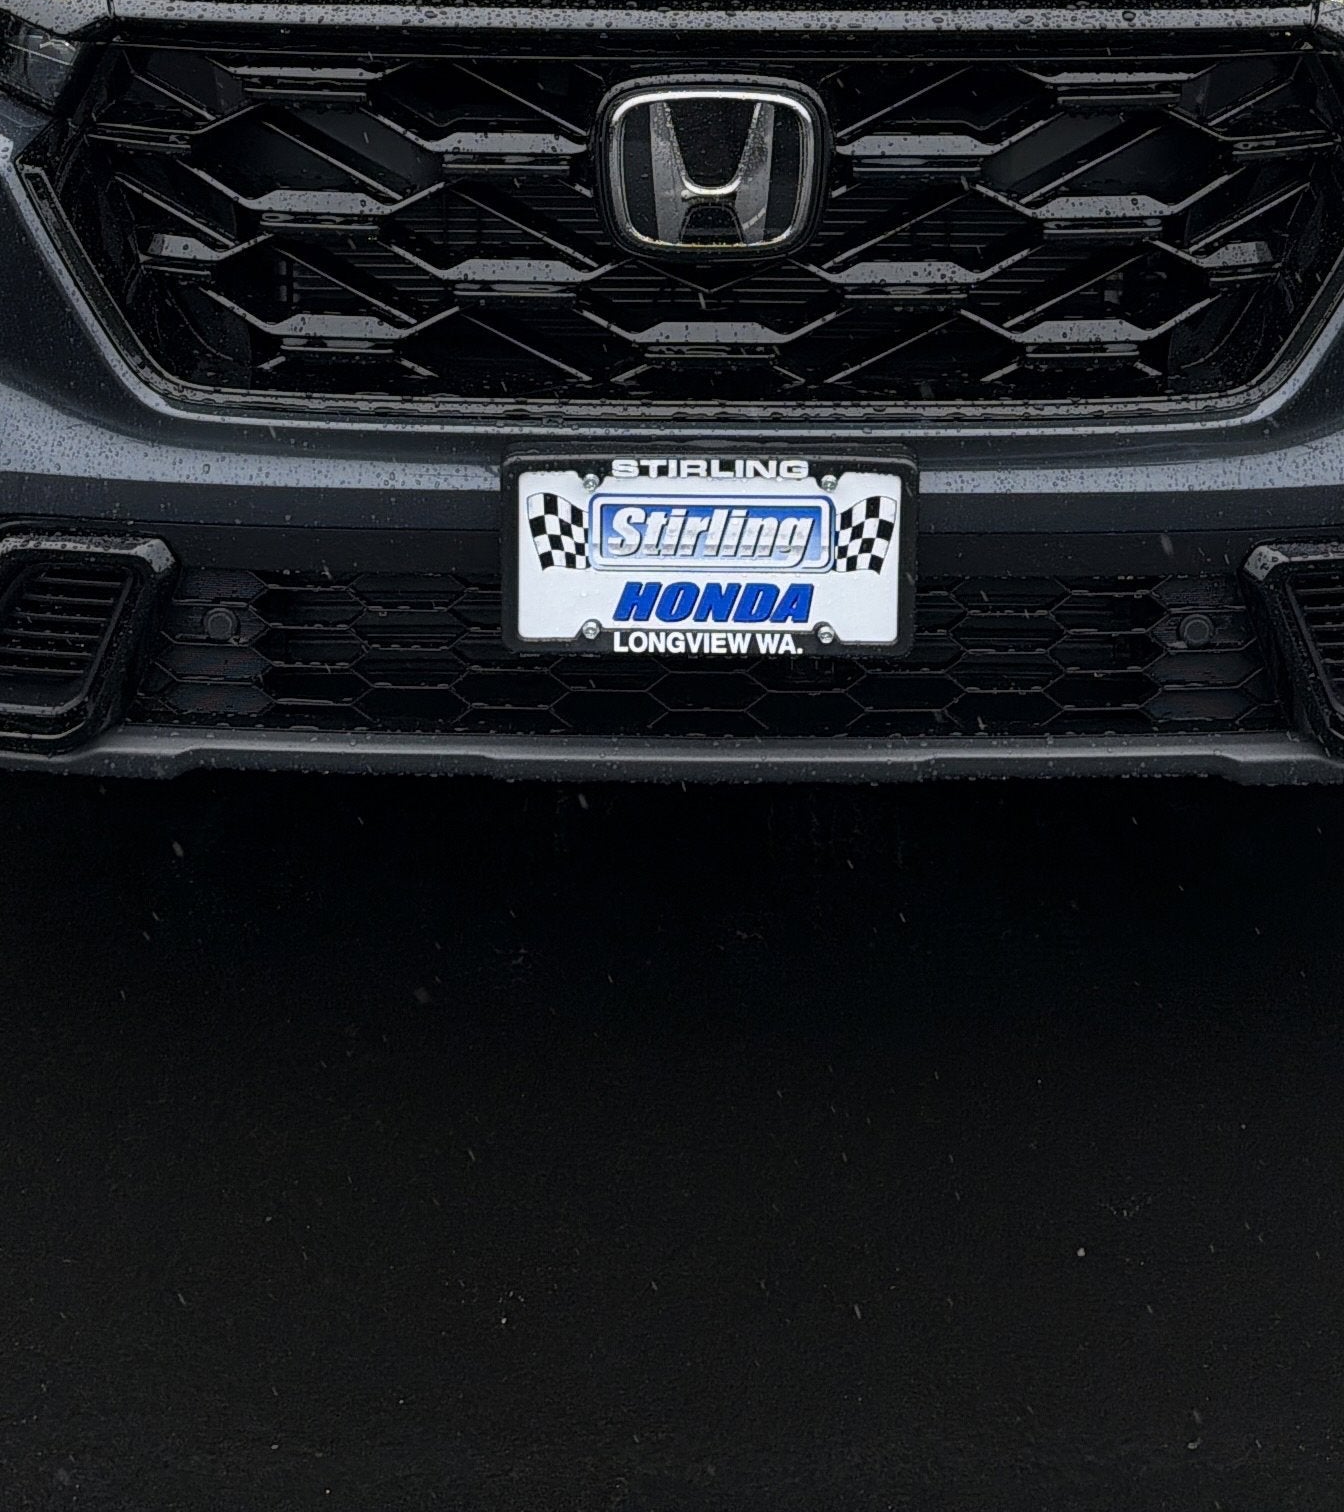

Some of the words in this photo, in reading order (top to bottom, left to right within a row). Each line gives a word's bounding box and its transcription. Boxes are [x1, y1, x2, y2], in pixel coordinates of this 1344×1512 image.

[611, 459, 809, 479] STIRLING
[606, 506, 815, 558] Stirling
[612, 581, 814, 623] HONDA
[613, 631, 754, 654] LONGVIEW
[755, 633, 803, 655] WA.
